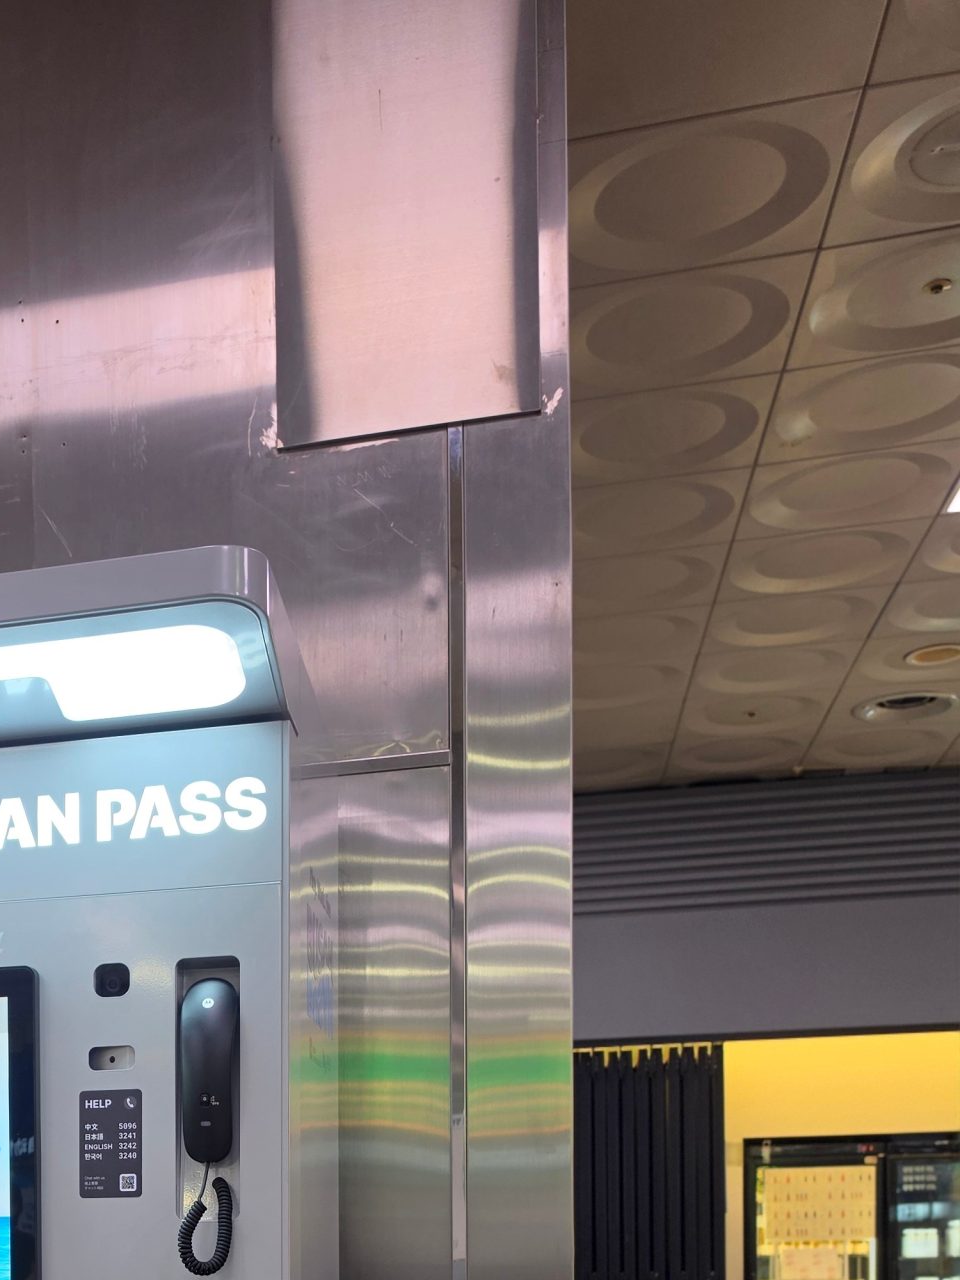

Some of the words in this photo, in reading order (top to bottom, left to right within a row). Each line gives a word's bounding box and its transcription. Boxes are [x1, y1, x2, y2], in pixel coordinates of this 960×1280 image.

[96, 776, 268, 842] PASS
[85, 1099, 112, 1109] HELP
[118, 1122, 137, 1130] 5096
[85, 1152, 103, 1160] 한국어
